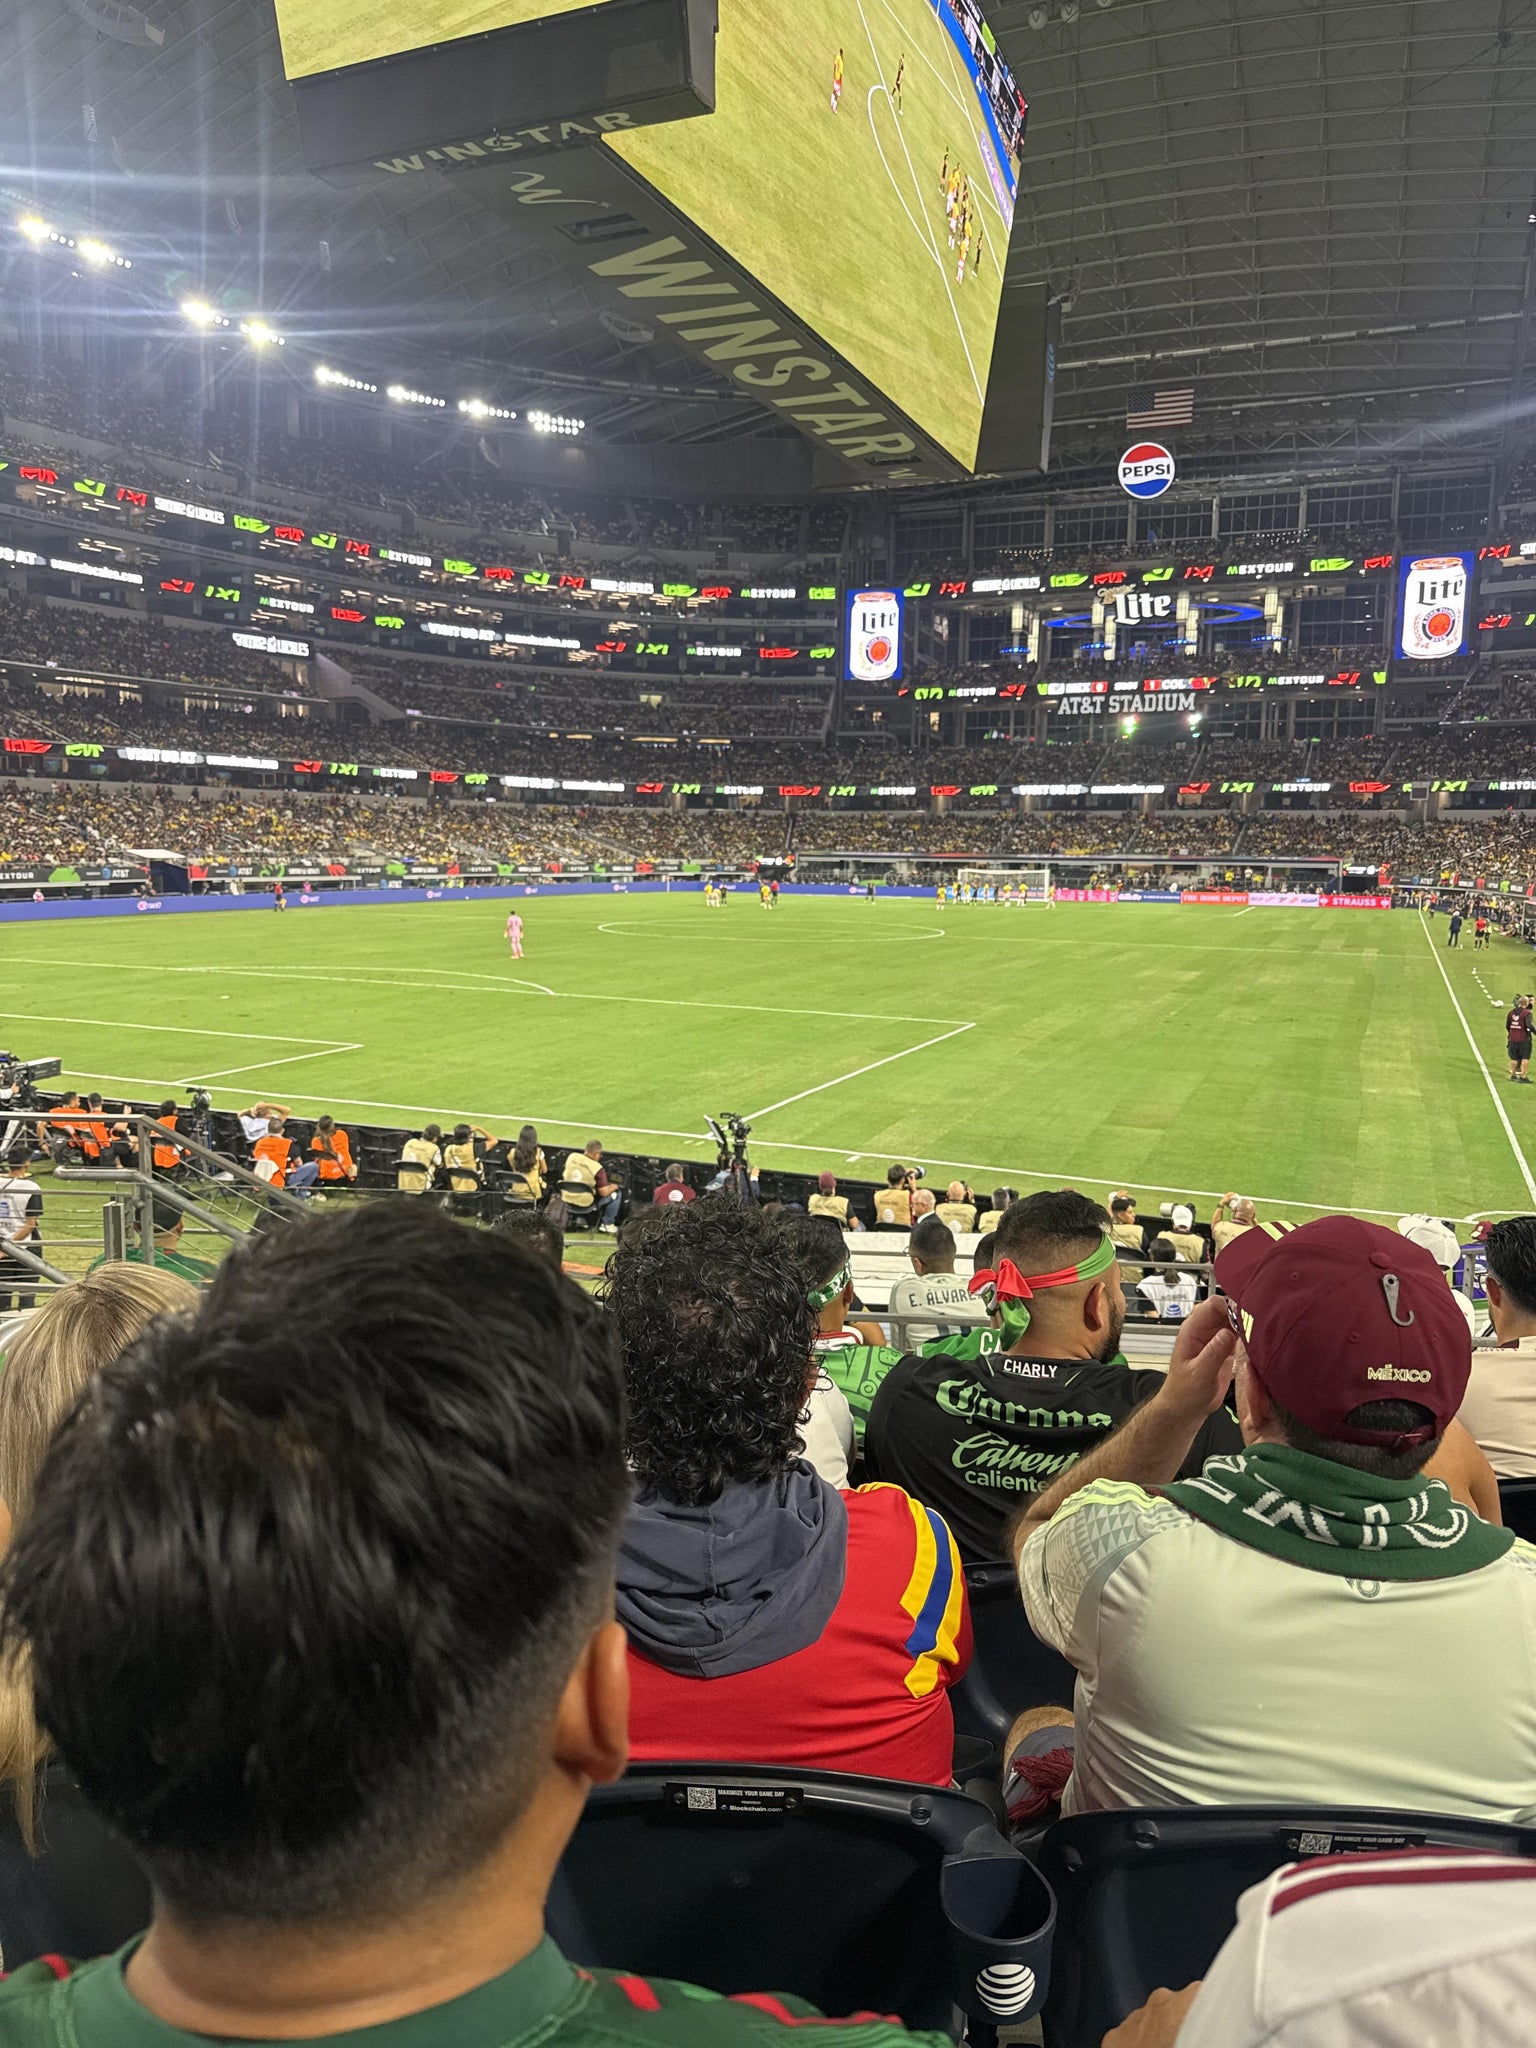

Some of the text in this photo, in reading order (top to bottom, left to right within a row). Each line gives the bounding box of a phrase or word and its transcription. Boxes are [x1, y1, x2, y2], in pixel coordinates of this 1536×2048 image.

[373, 112, 638, 175] WINSTAR
[587, 235, 916, 458] WINSTAR
[1122, 464, 1171, 478] PEPSI
[379, 549, 432, 567] MEXTOUR
[1227, 562, 1293, 576] MEXTOUR
[740, 588, 796, 598] MEXTOUR
[1416, 580, 1464, 606] Lite
[259, 596, 315, 614] MEXTOUR
[1114, 593, 1172, 626] Lite
[862, 612, 897, 634] Lite
[1161, 678, 1188, 689] COL
[1267, 675, 1324, 686] MEXTOUR
[1058, 693, 1196, 715] AT&T STADIUM
[1272, 783, 1331, 793] MEXTOUR
[112, 869, 130, 879] AT&T
[1420, 877, 1434, 885] AT&T
[1332, 896, 1377, 906] STRAUSS
[909, 1288, 981, 1307] E. ÁLVARE
[1003, 1358, 1058, 1378] CHARLY
[1368, 1364, 1432, 1383] MÉXICO
[952, 1430, 1081, 1476] Calient
[729, 1804, 783, 1813] Blockchain.com
